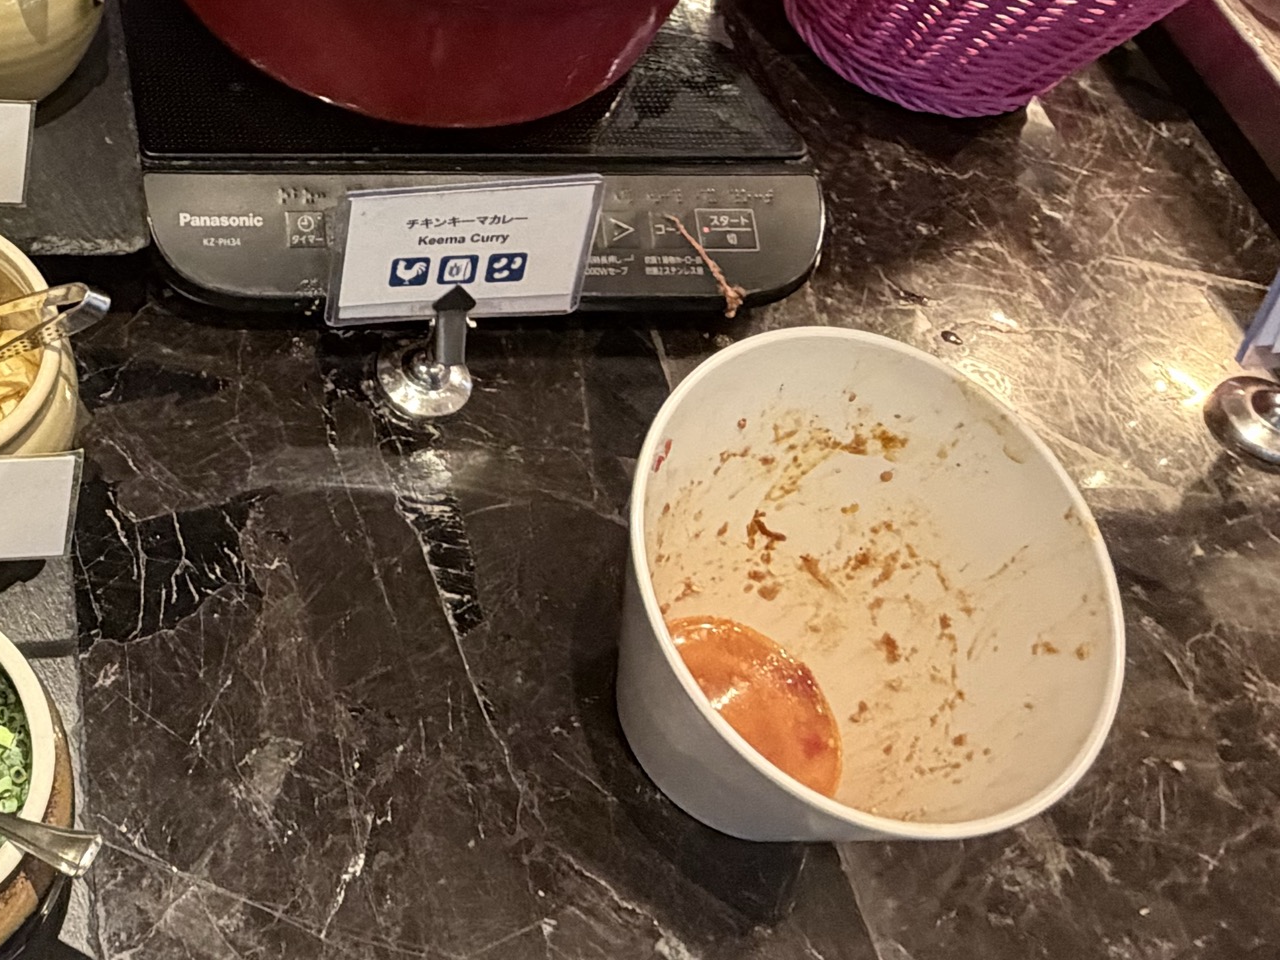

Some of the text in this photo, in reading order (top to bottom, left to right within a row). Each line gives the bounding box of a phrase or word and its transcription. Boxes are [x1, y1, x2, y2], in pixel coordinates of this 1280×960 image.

[178, 212, 264, 228] Panasonic
[406, 214, 529, 230] チキンキーマカレー
[709, 215, 750, 226] スタート
[654, 224, 682, 235] コー
[292, 234, 324, 245] タイマー
[417, 232, 510, 247] Keema Curry
